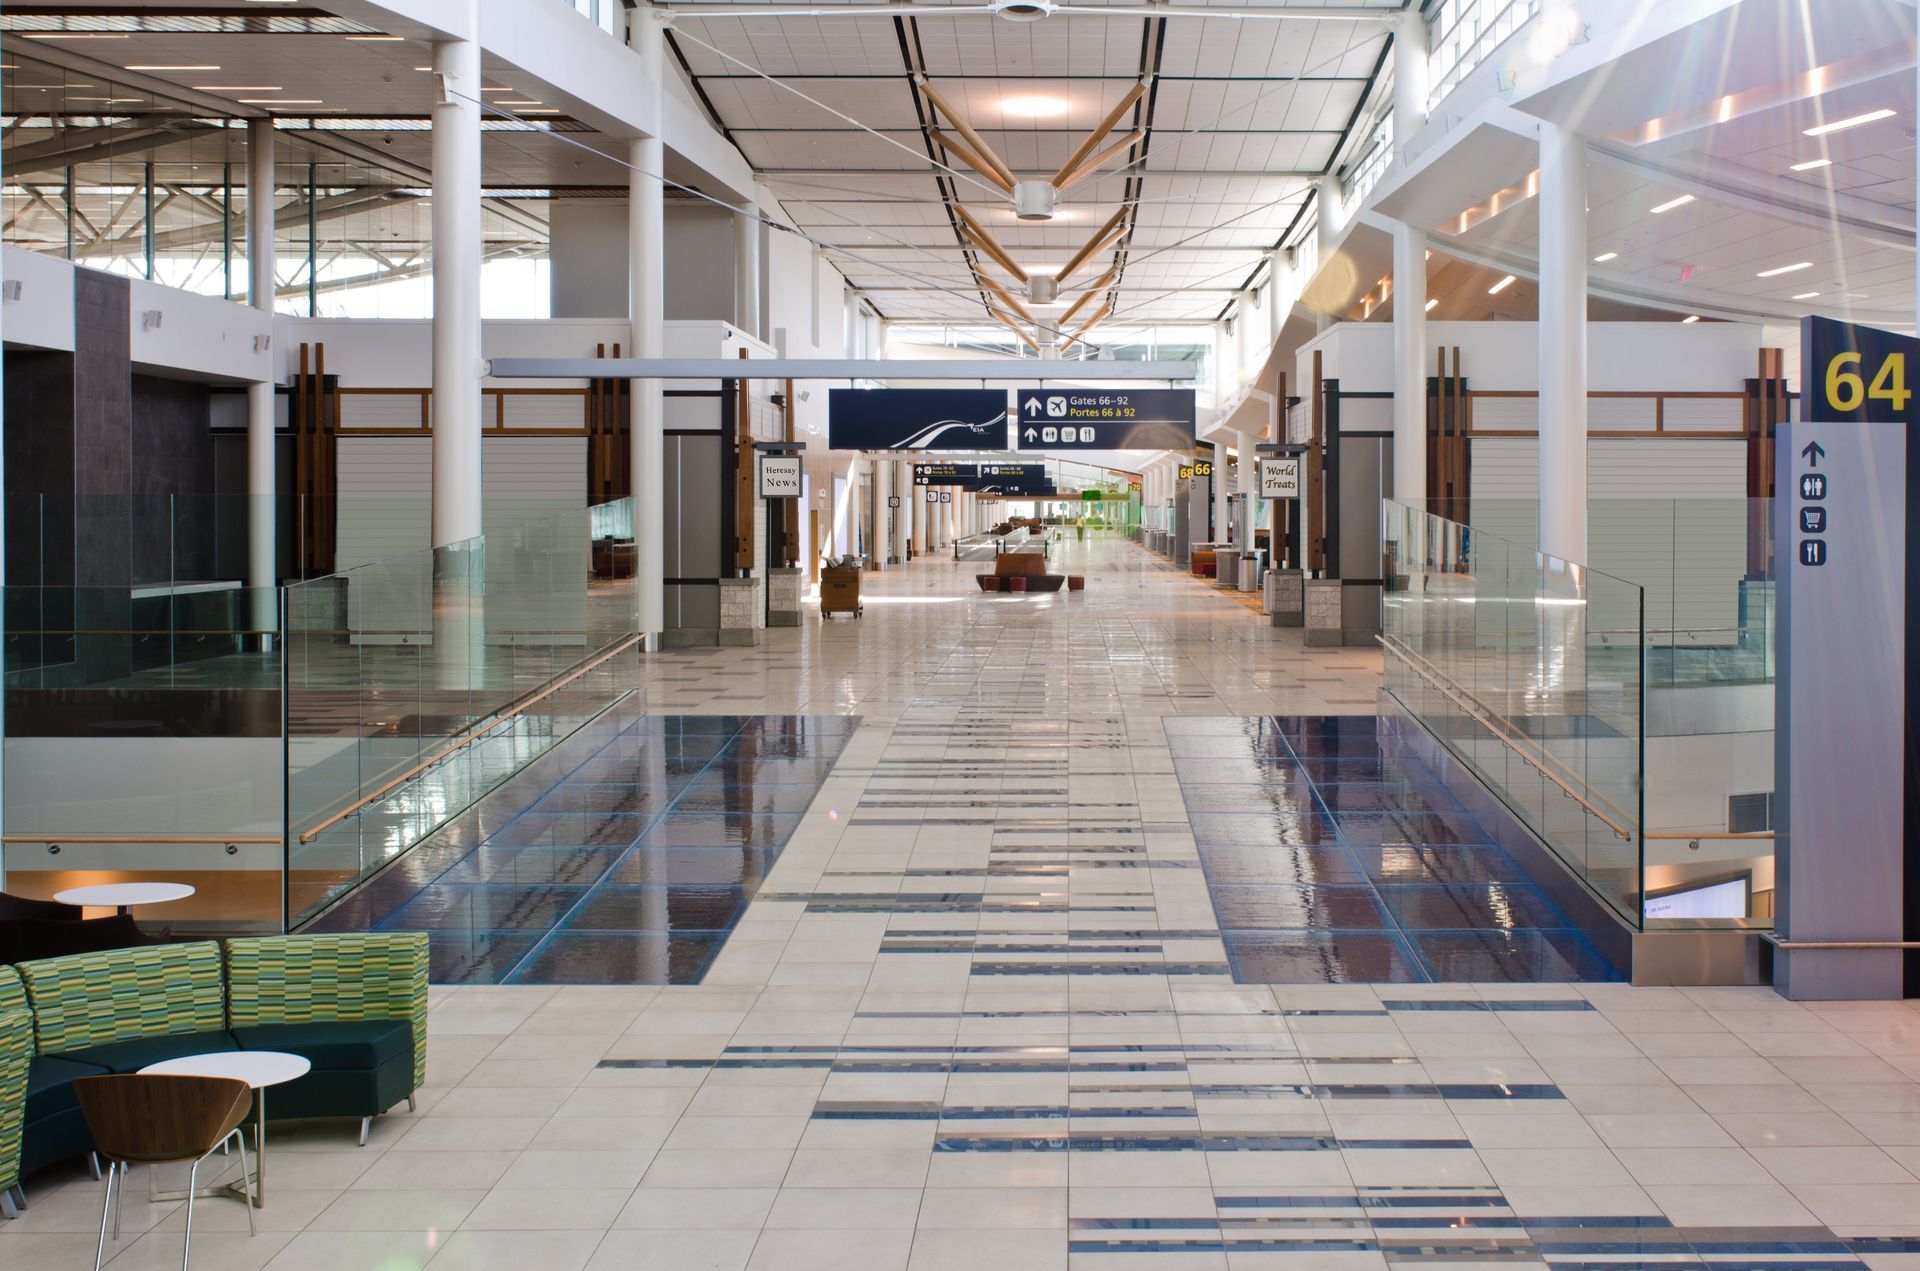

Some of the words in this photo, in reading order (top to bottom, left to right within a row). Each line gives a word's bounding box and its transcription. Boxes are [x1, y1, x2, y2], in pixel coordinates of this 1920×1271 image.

[1825, 351, 1912, 412] 64
[1070, 396, 1097, 405] Gates
[1070, 408, 1099, 417] Portes
[1101, 408, 1113, 417] 66
[1115, 408, 1121, 417] à
[1124, 408, 1135, 417] 92
[766, 467, 796, 475] Heresay
[1180, 468, 1193, 478] 68
[1195, 464, 1210, 475] 66
[1266, 464, 1296, 476] World
[767, 478, 797, 487] News
[1265, 477, 1296, 489] Treats
